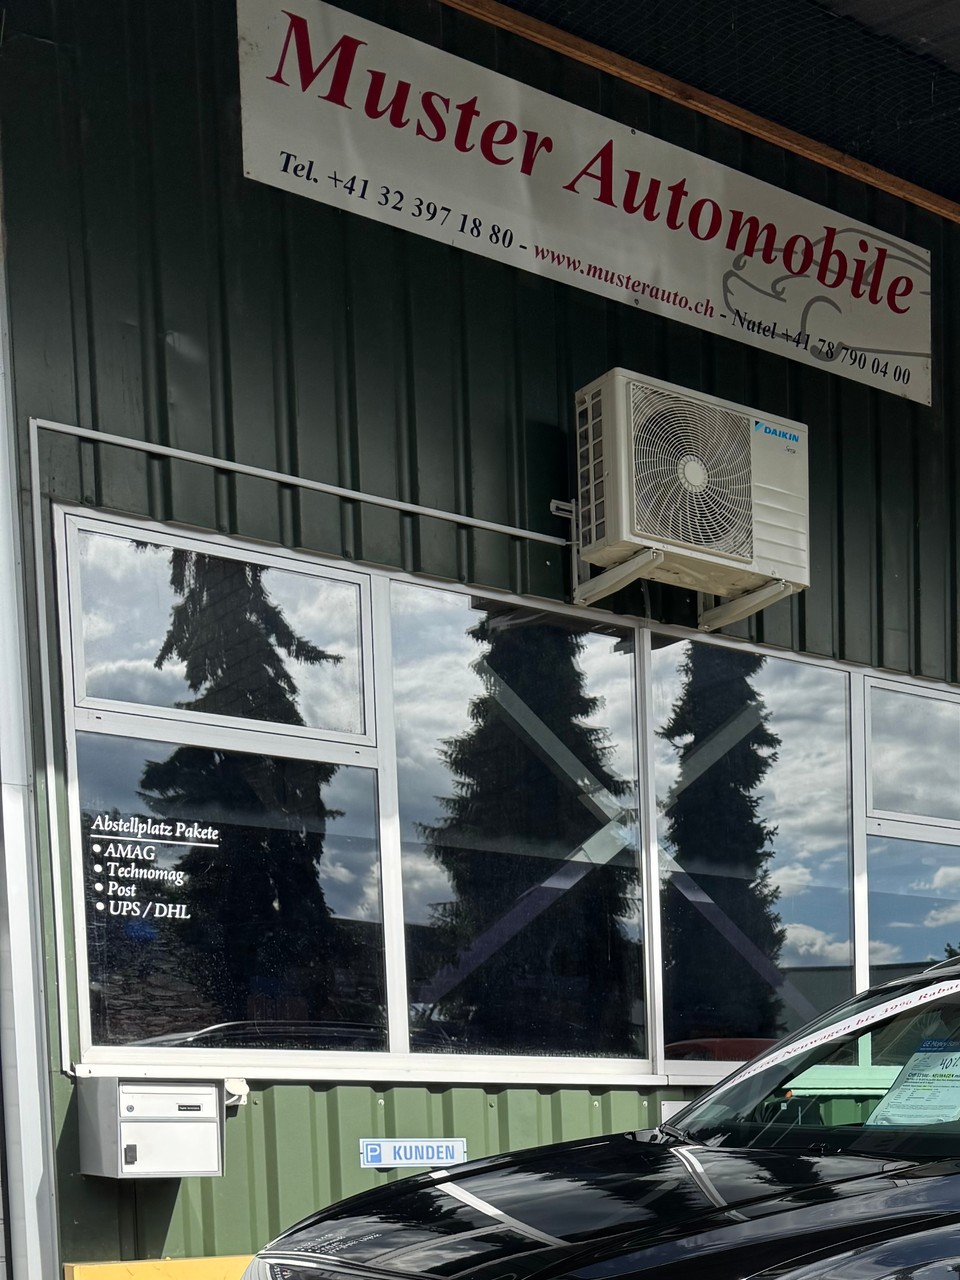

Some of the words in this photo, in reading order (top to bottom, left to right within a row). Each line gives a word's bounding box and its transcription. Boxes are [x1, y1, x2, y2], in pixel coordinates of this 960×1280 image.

[266, 9, 554, 177] Muster
[562, 138, 914, 315] Automobile
[279, 151, 319, 184] Tel.
[327, 170, 368, 201] +41
[377, 185, 405, 212] 32
[411, 196, 452, 227] 397
[457, 212, 483, 239] 18
[488, 223, 514, 250] 80
[534, 244, 715, 319] www.musterauto.ch
[732, 308, 777, 340] Natel
[781, 328, 811, 351] +41
[817, 338, 835, 360] 78
[841, 345, 867, 370] 790
[871, 357, 889, 378] 04
[893, 365, 911, 385] 00
[763, 426, 800, 443] DAIKIN
[91, 815, 173, 838] Abstellplatz
[175, 822, 220, 840] Pakete
[104, 843, 156, 861] AMAG
[107, 862, 185, 886] Technomag
[107, 881, 137, 898] Post
[109, 900, 141, 917] UPS
[154, 902, 191, 919] DHL
[781, 1024, 851, 1058] Neuwagen
[855, 1014, 875, 1027] bis
[393, 1144, 455, 1161] KUNDEN
